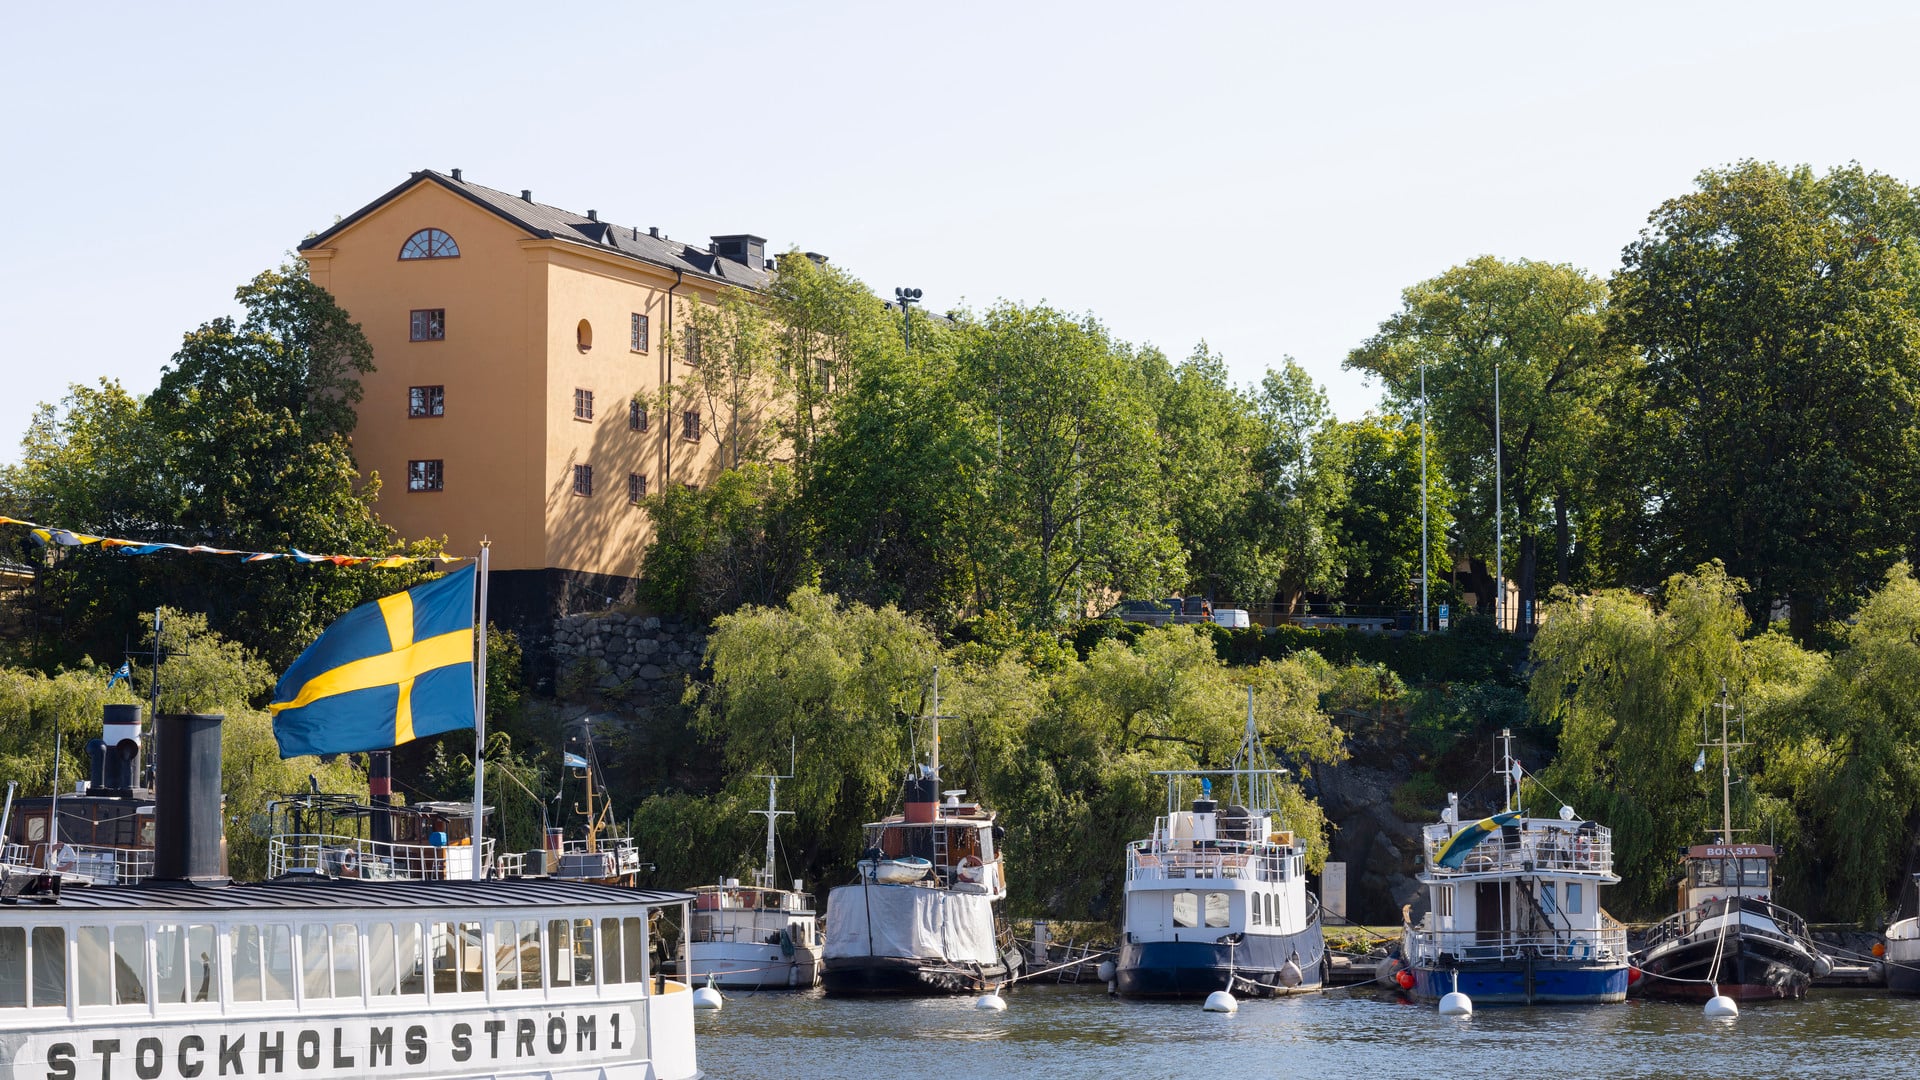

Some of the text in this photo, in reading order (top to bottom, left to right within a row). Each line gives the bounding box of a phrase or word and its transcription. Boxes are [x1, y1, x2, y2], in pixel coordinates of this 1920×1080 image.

[46, 1011, 623, 1080] STOCKHOLMS STRÖM 1
